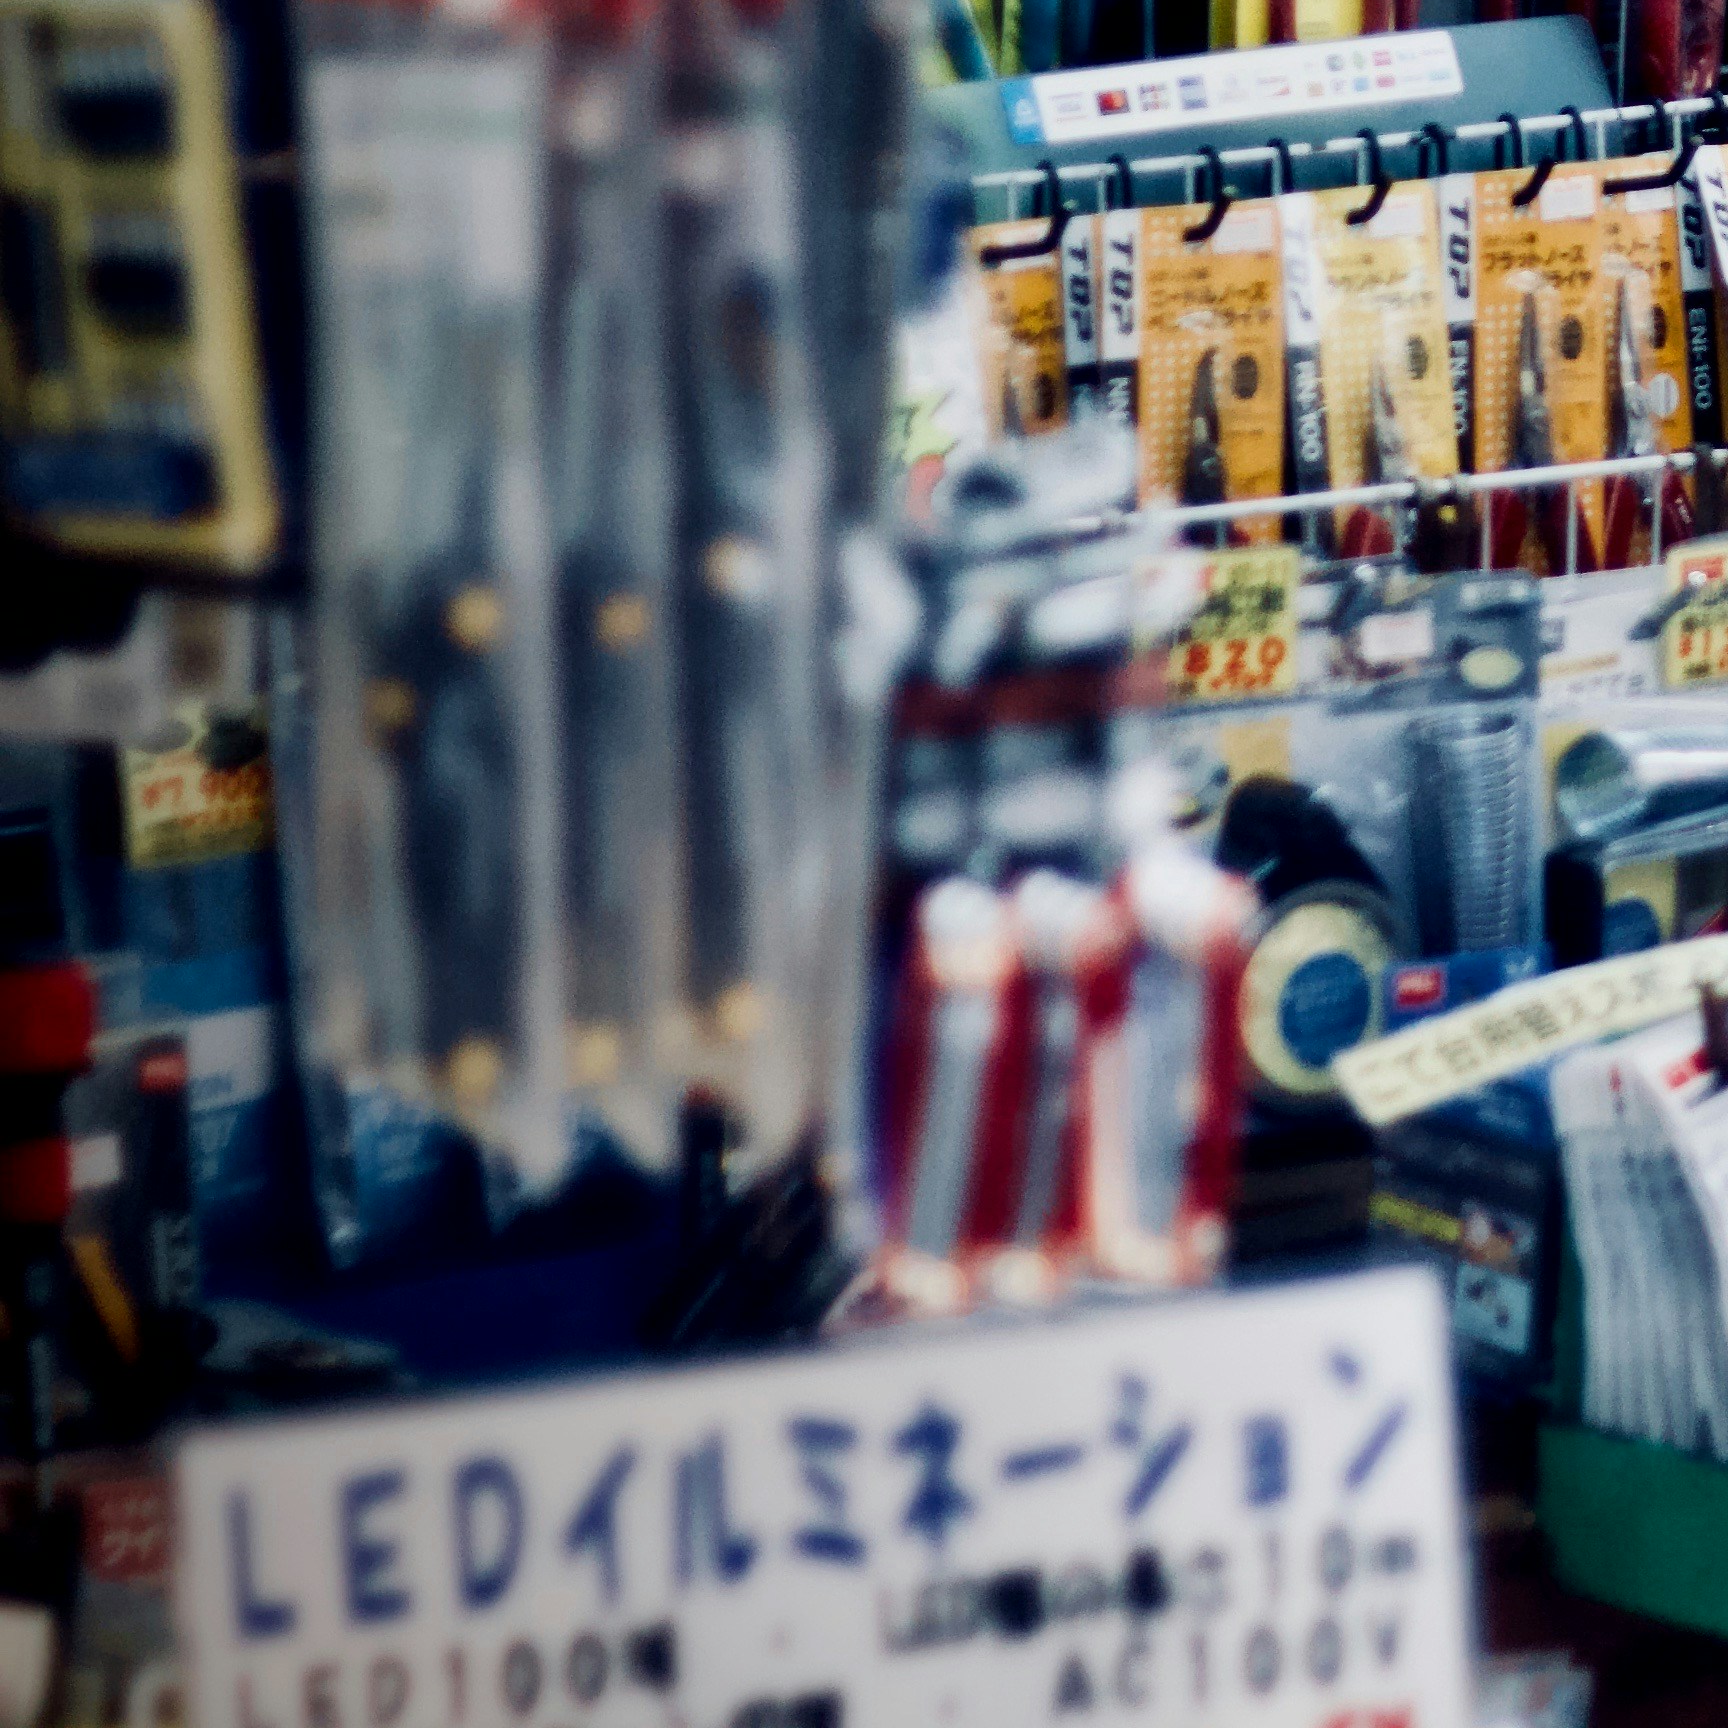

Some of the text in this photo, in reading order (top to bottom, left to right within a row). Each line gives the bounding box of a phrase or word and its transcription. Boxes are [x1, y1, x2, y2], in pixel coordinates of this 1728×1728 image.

[1108, 230, 1136, 337] TOP
[1447, 196, 1472, 301] TOP
[226, 1344, 1410, 1640] LEDイルミネーション
